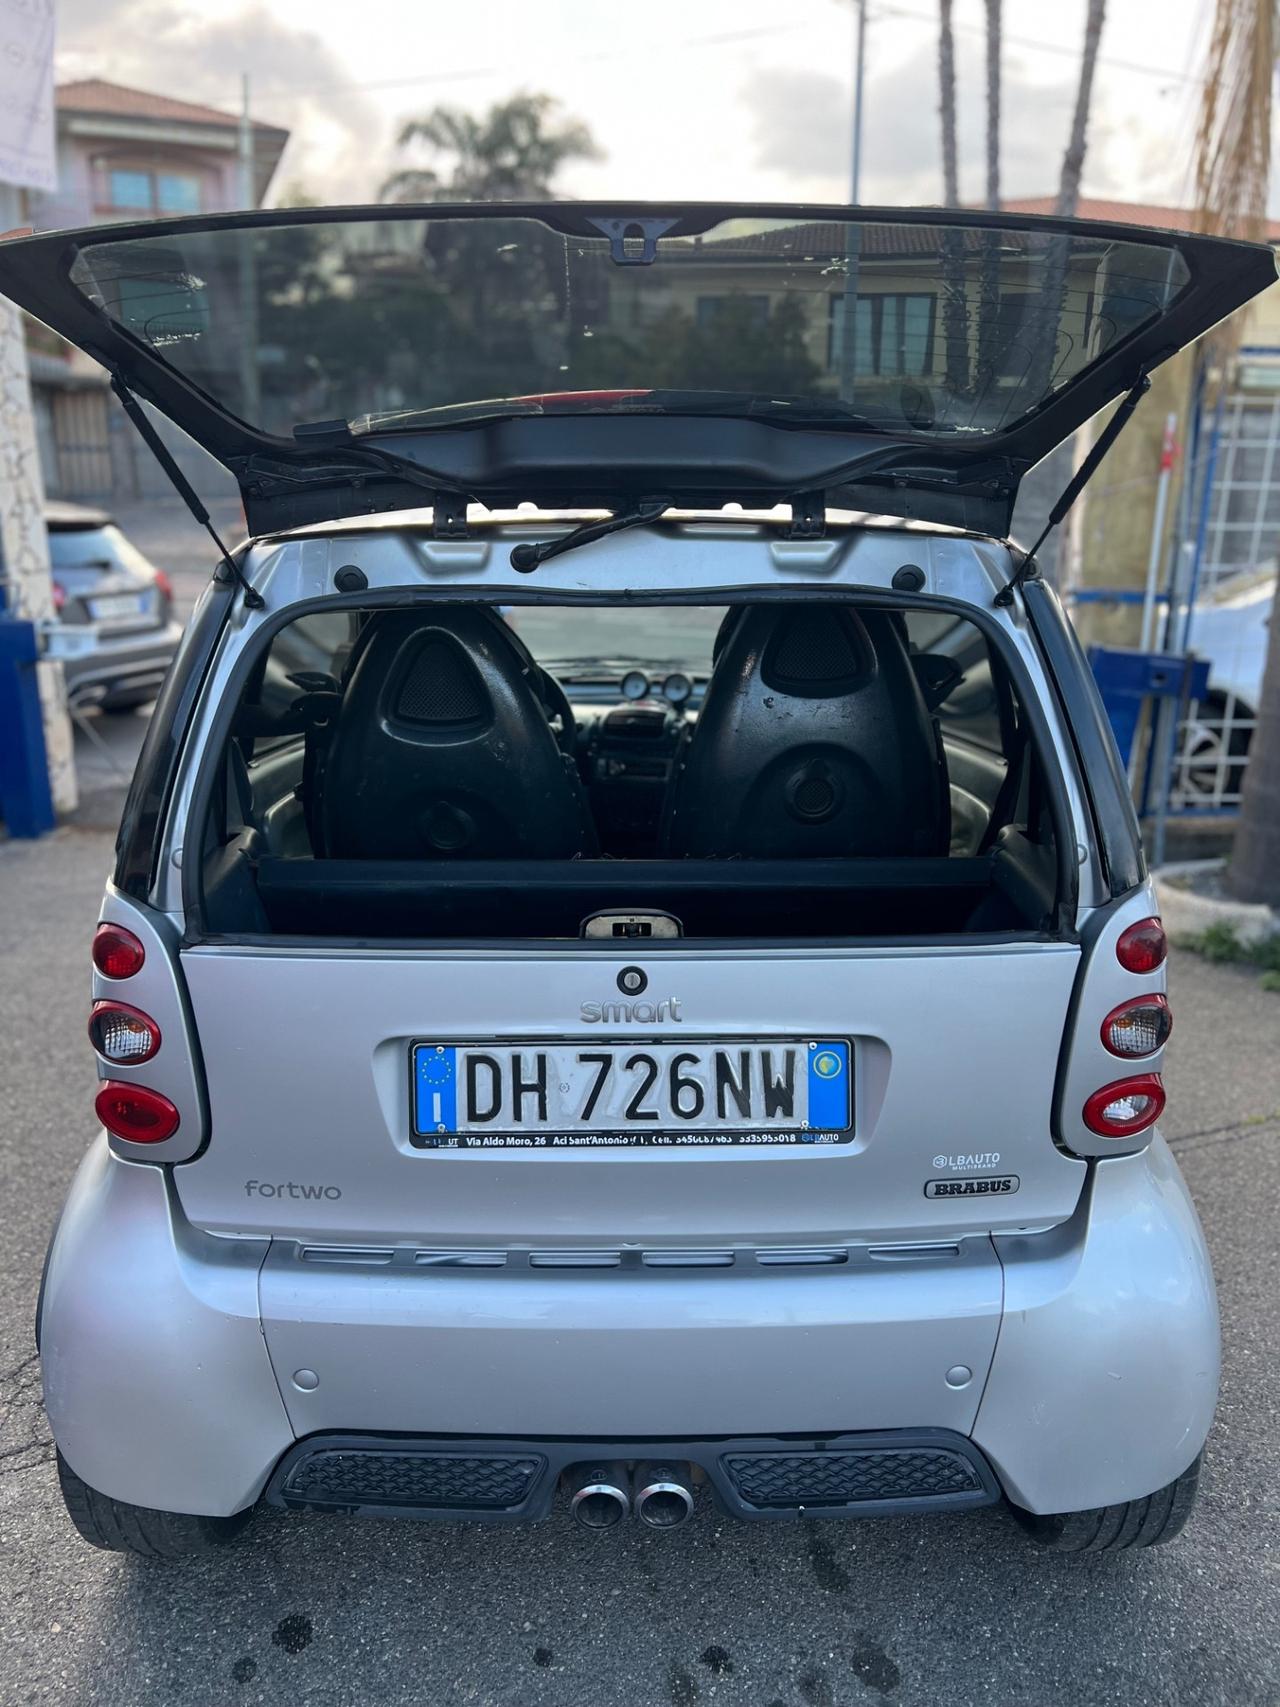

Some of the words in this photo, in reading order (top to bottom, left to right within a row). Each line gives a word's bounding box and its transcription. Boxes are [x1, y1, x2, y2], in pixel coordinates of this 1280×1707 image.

[580, 997, 682, 1023] smart
[466, 1137, 480, 1146] Via
[483, 1136, 504, 1146] Aldo
[506, 1136, 533, 1146] Moro,
[534, 1136, 546, 1145] 26
[553, 1136, 567, 1145] Aci
[244, 1180, 342, 1200] fortwo
[934, 1180, 1011, 1195] BRABUS
